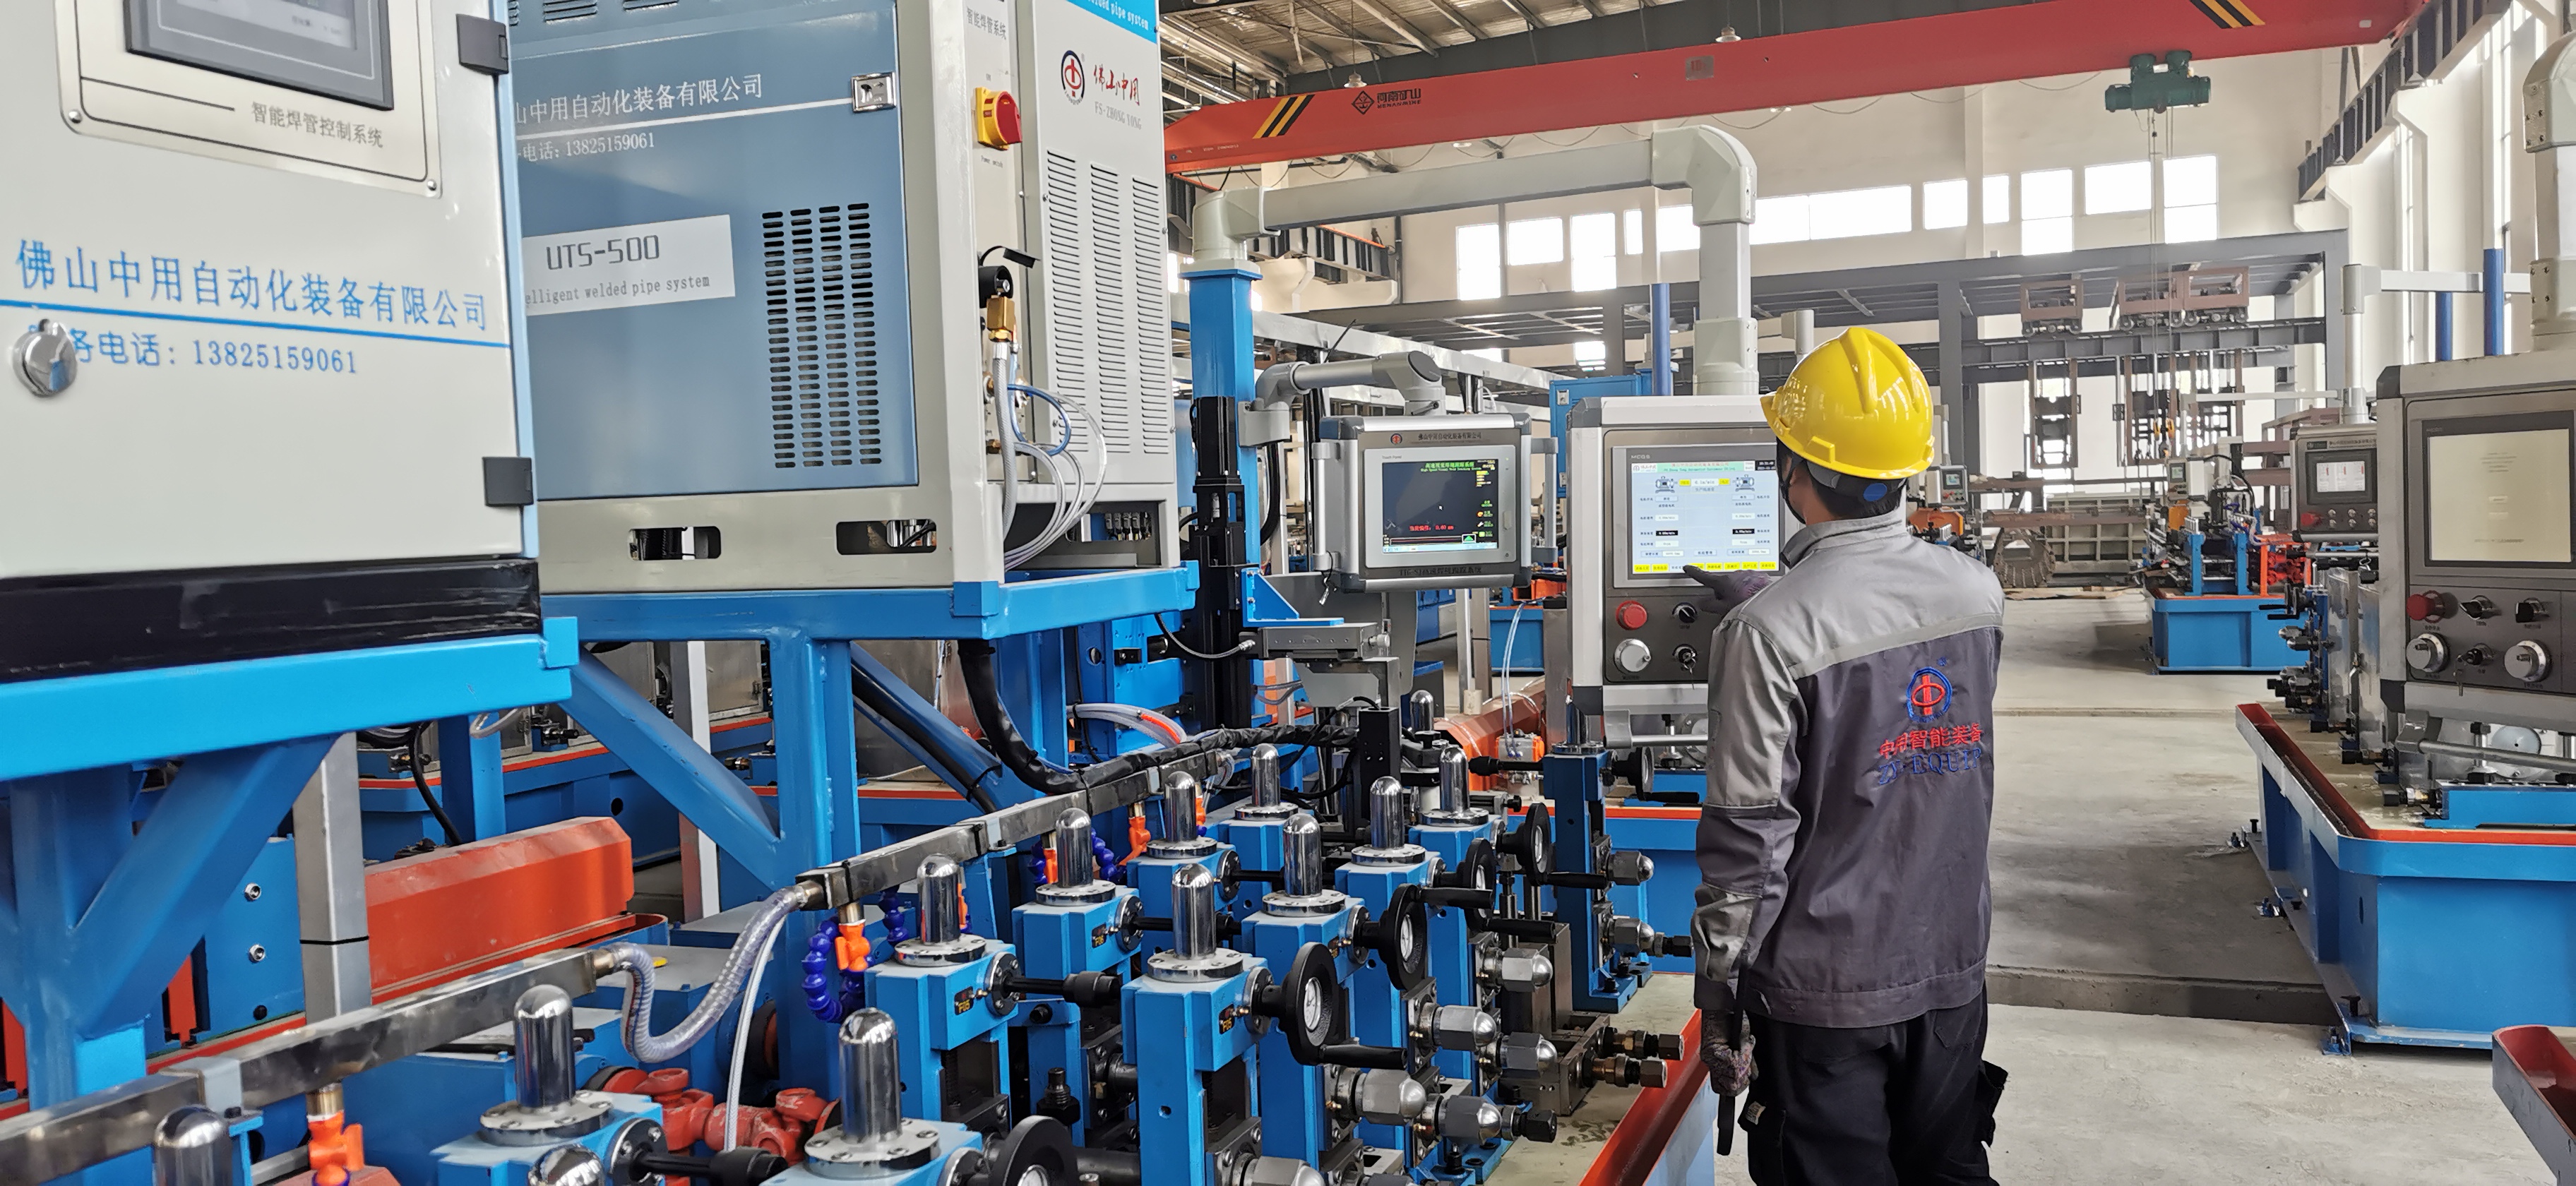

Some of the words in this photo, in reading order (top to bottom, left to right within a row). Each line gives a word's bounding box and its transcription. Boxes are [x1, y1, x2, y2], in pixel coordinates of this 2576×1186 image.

[967, 6, 1006, 40] 智能焊管系统
[1111, 1, 1126, 19] pipe
[1128, 11, 1149, 30] system
[251, 101, 383, 148] 智能焊管控制系统
[566, 133, 655, 157] 13825159061
[547, 234, 660, 270] UTS-500
[16, 239, 486, 331] 佛山中用自动化装备有限公司
[585, 280, 627, 299] welded
[632, 279, 661, 297] pipe
[666, 275, 710, 293] system
[193, 339, 357, 374] 13825159061
[1878, 723, 1982, 760] 中用智能装备
